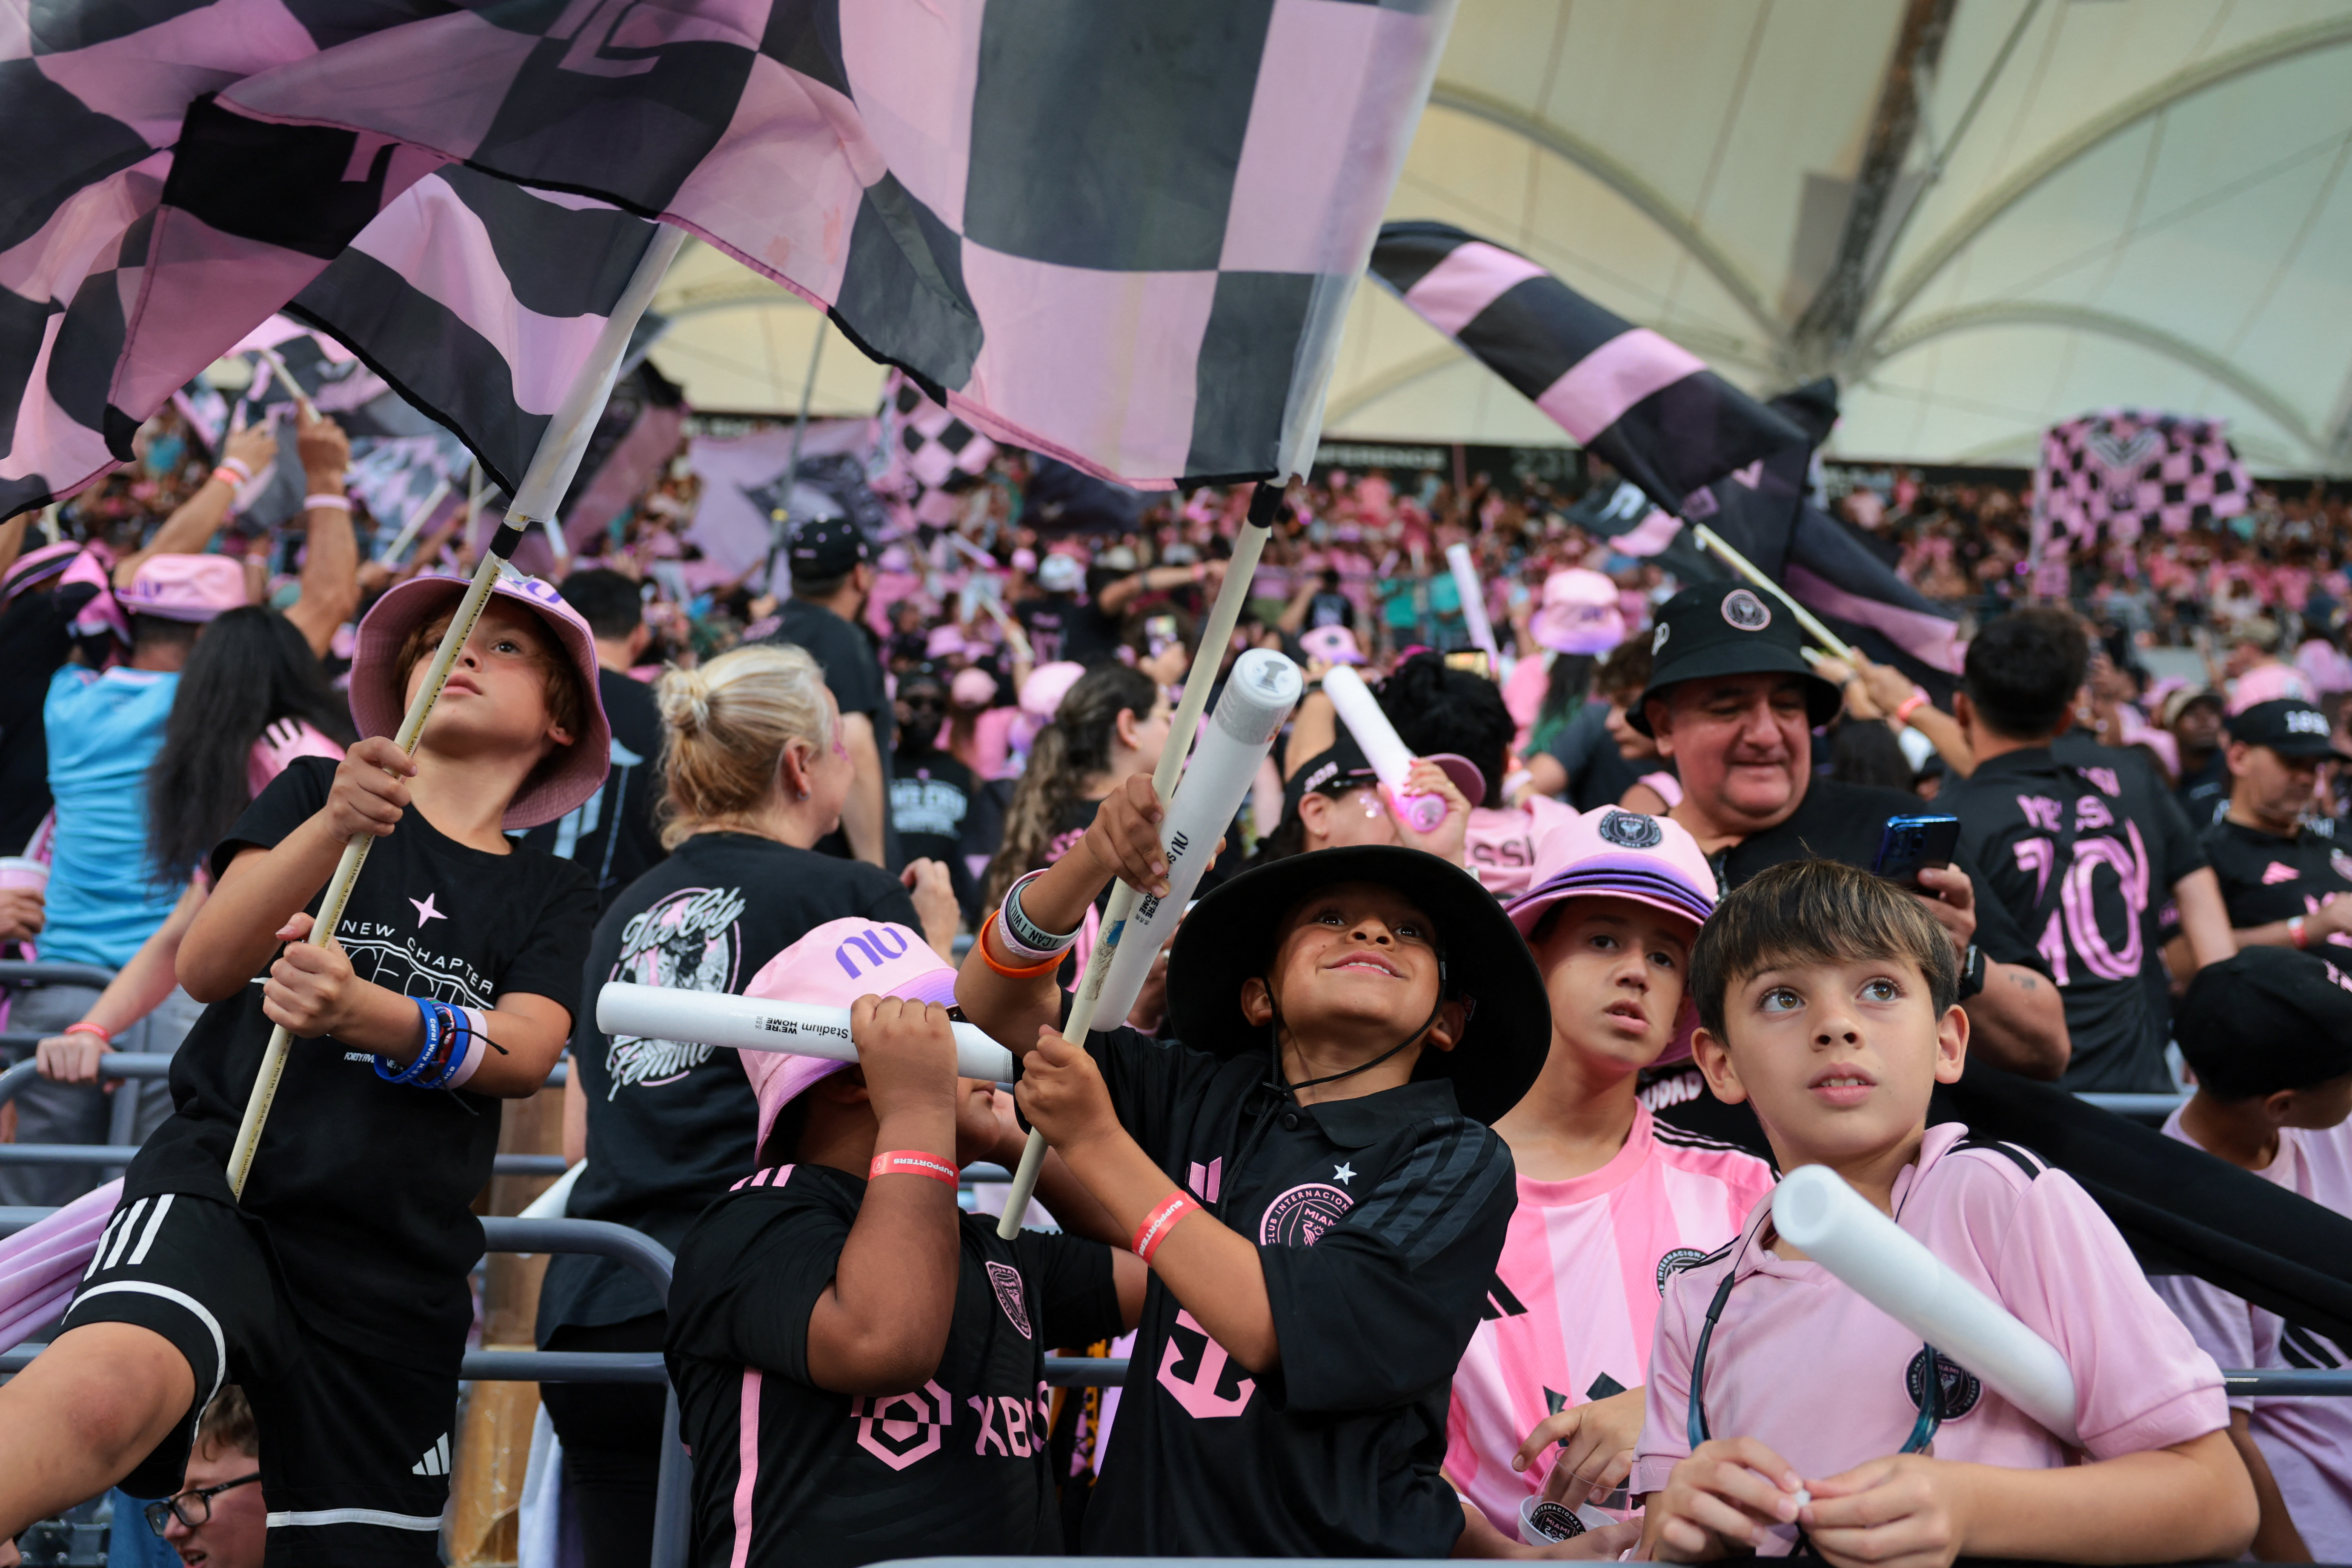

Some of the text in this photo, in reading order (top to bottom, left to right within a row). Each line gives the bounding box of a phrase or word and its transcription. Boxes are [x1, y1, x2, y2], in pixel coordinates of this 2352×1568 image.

[424, 573, 498, 714] CHARLOTTE PIPE
[1171, 830, 1189, 856] NU
[349, 853, 365, 883] TUBING
[338, 888, 349, 909] 4120
[618, 886, 746, 961] Vice City
[1020, 923, 1027, 933] I
[836, 926, 908, 979] NU
[1051, 939, 1059, 948] I
[341, 919, 396, 937] NEW
[406, 937, 494, 995] CHAPTER
[765, 1024, 797, 1035] WE'RE
[766, 1017, 798, 1027] HOME
[801, 1022, 849, 1039] Stadium
[422, 1044, 436, 1062] Way
[269, 1067, 280, 1088] ASTM
[893, 1158, 954, 1177] SUPPORTERS
[1139, 1200, 1184, 1256] SUPPORTERS
[1533, 1505, 1581, 1529] INTERNACIONAL
[1546, 1517, 1571, 1534] MIAMI
